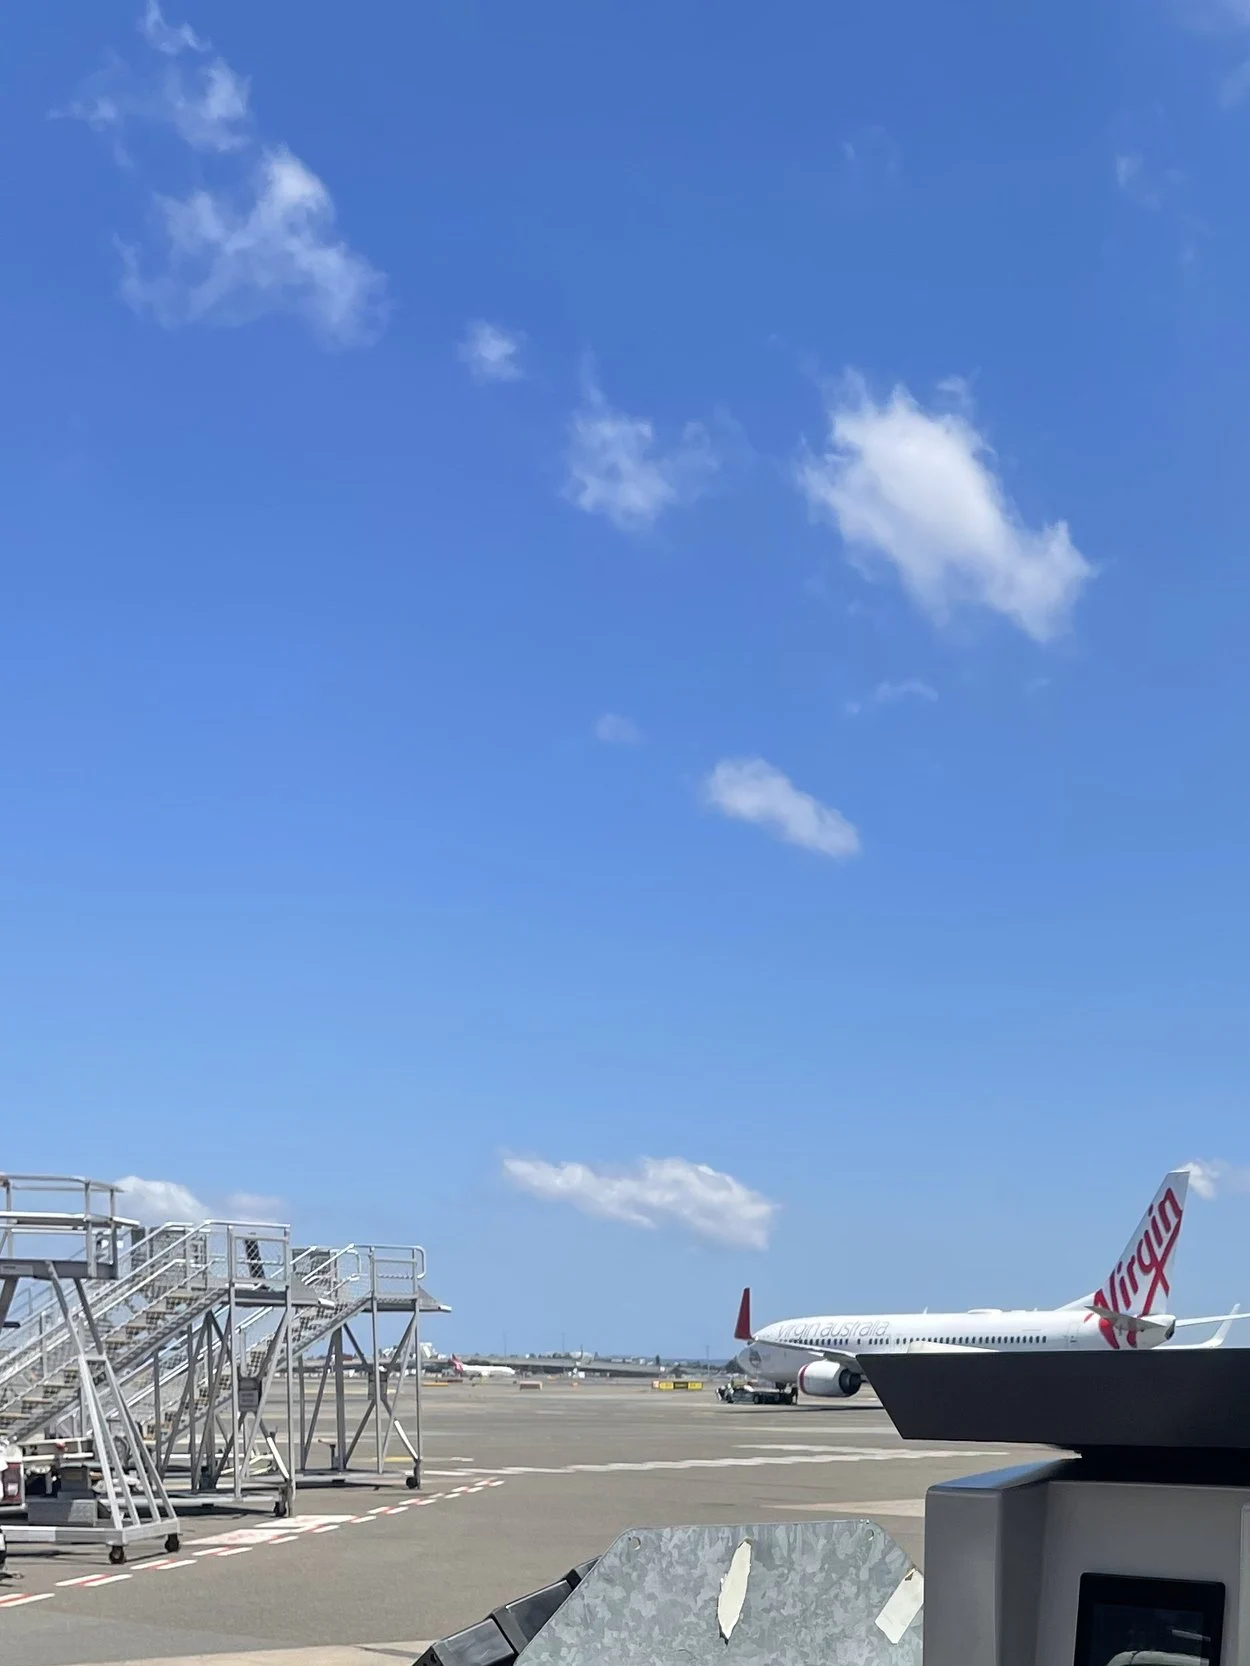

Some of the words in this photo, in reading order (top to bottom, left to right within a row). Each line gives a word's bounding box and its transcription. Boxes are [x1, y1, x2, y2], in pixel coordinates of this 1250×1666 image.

[1094, 1187, 1183, 1348] Virgin
[778, 1321, 821, 1340] virgin
[820, 1319, 890, 1337] australia
